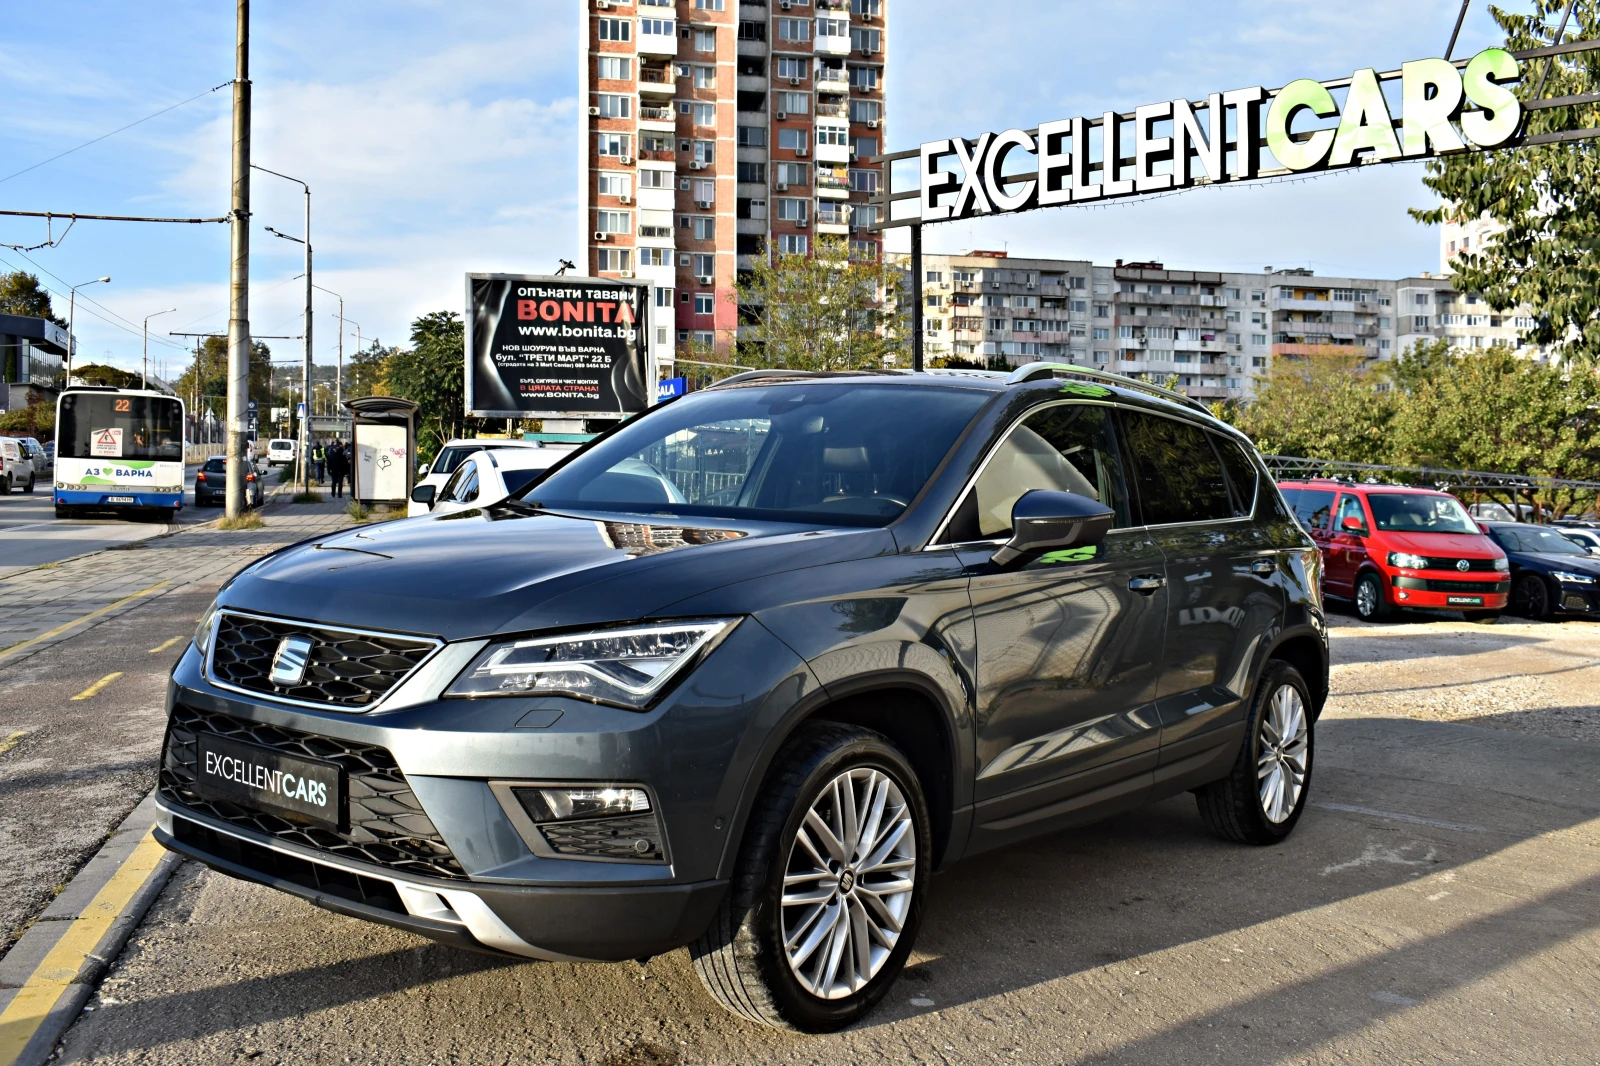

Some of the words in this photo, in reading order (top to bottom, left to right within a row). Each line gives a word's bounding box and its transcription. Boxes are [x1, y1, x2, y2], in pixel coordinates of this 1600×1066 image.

[517, 286, 581, 299] опънати
[585, 288, 637, 301] тавани
[517, 299, 636, 323] BONITA
[518, 325, 637, 340] www.bonita.bg
[521, 344, 557, 352] ШОУРУМ
[558, 345, 577, 353] ВЪВ
[495, 353, 517, 363] бул.
[591, 355, 603, 363] 22
[604, 355, 612, 363] Б
[520, 391, 600, 400] www.BONITA.bg
[115, 399, 131, 412] 22
[85, 468, 101, 476] АЗ
[115, 469, 153, 478] ВАРНА
